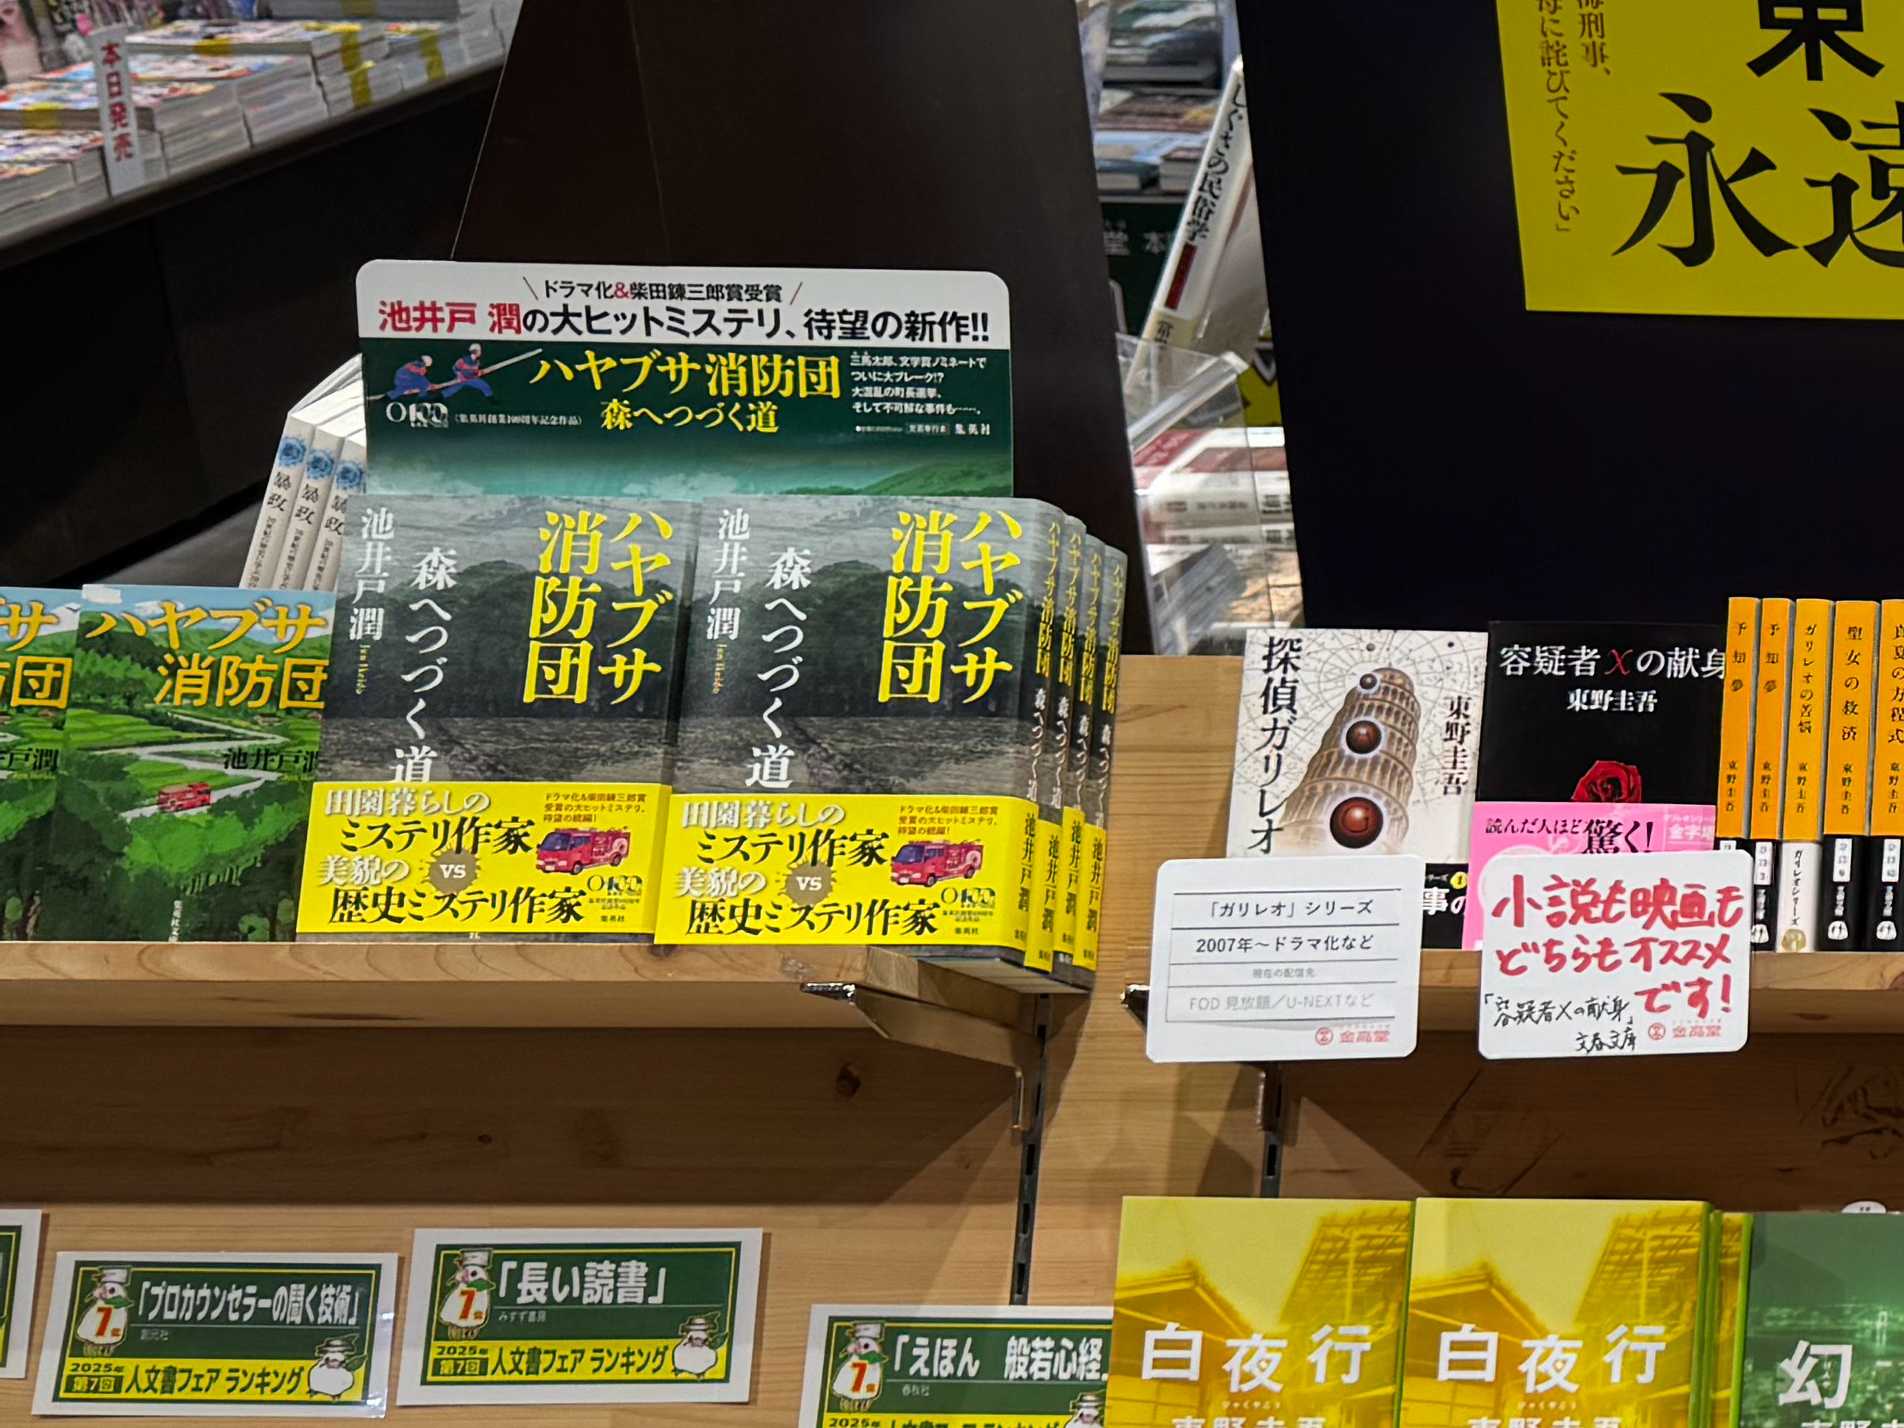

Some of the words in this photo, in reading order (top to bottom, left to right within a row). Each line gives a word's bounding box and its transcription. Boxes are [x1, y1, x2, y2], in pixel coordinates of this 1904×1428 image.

[544, 280, 783, 302] ドラマ化&柴田錬三郎賞受賞
[378, 300, 476, 332] 池井戸
[530, 349, 839, 399] ハヤブサ消防団
[600, 400, 779, 433] 森へつづく道
[706, 506, 751, 642] 池井戸潤
[92, 599, 326, 655] ハヤブサ
[877, 508, 955, 704] 消防団
[950, 508, 1022, 704] ハヤブサ
[750, 545, 811, 789] 森へつづく道
[1500, 647, 1726, 680] 容疑者Xの献身
[1841, 626, 1864, 742] 聖女の救済
[1567, 689, 1658, 713] 東野圭吾
[1248, 636, 1303, 855] 探偵ガリレオ
[1441, 694, 1472, 796] 東野圭吾
[325, 789, 489, 816] 田園暮らしの
[340, 815, 536, 856] ミステリ作家
[317, 854, 409, 887] 美貌の
[331, 885, 584, 928] 歴史ミステリ作家
[1496, 936, 1732, 975] どちらもオススメ
[1189, 996, 1220, 1011] FOD
[1339, 1028, 1391, 1044] 金高堂
[136, 1281, 362, 1326] 「プロカウンセラーの聞く技術」
[496, 1258, 668, 1306] 「長い読書」
[894, 1332, 981, 1376] 「えほん
[1006, 1335, 1108, 1383] 般若心経
[1140, 1321, 1374, 1394] 白夜行
[1436, 1322, 1668, 1394] 白夜行
